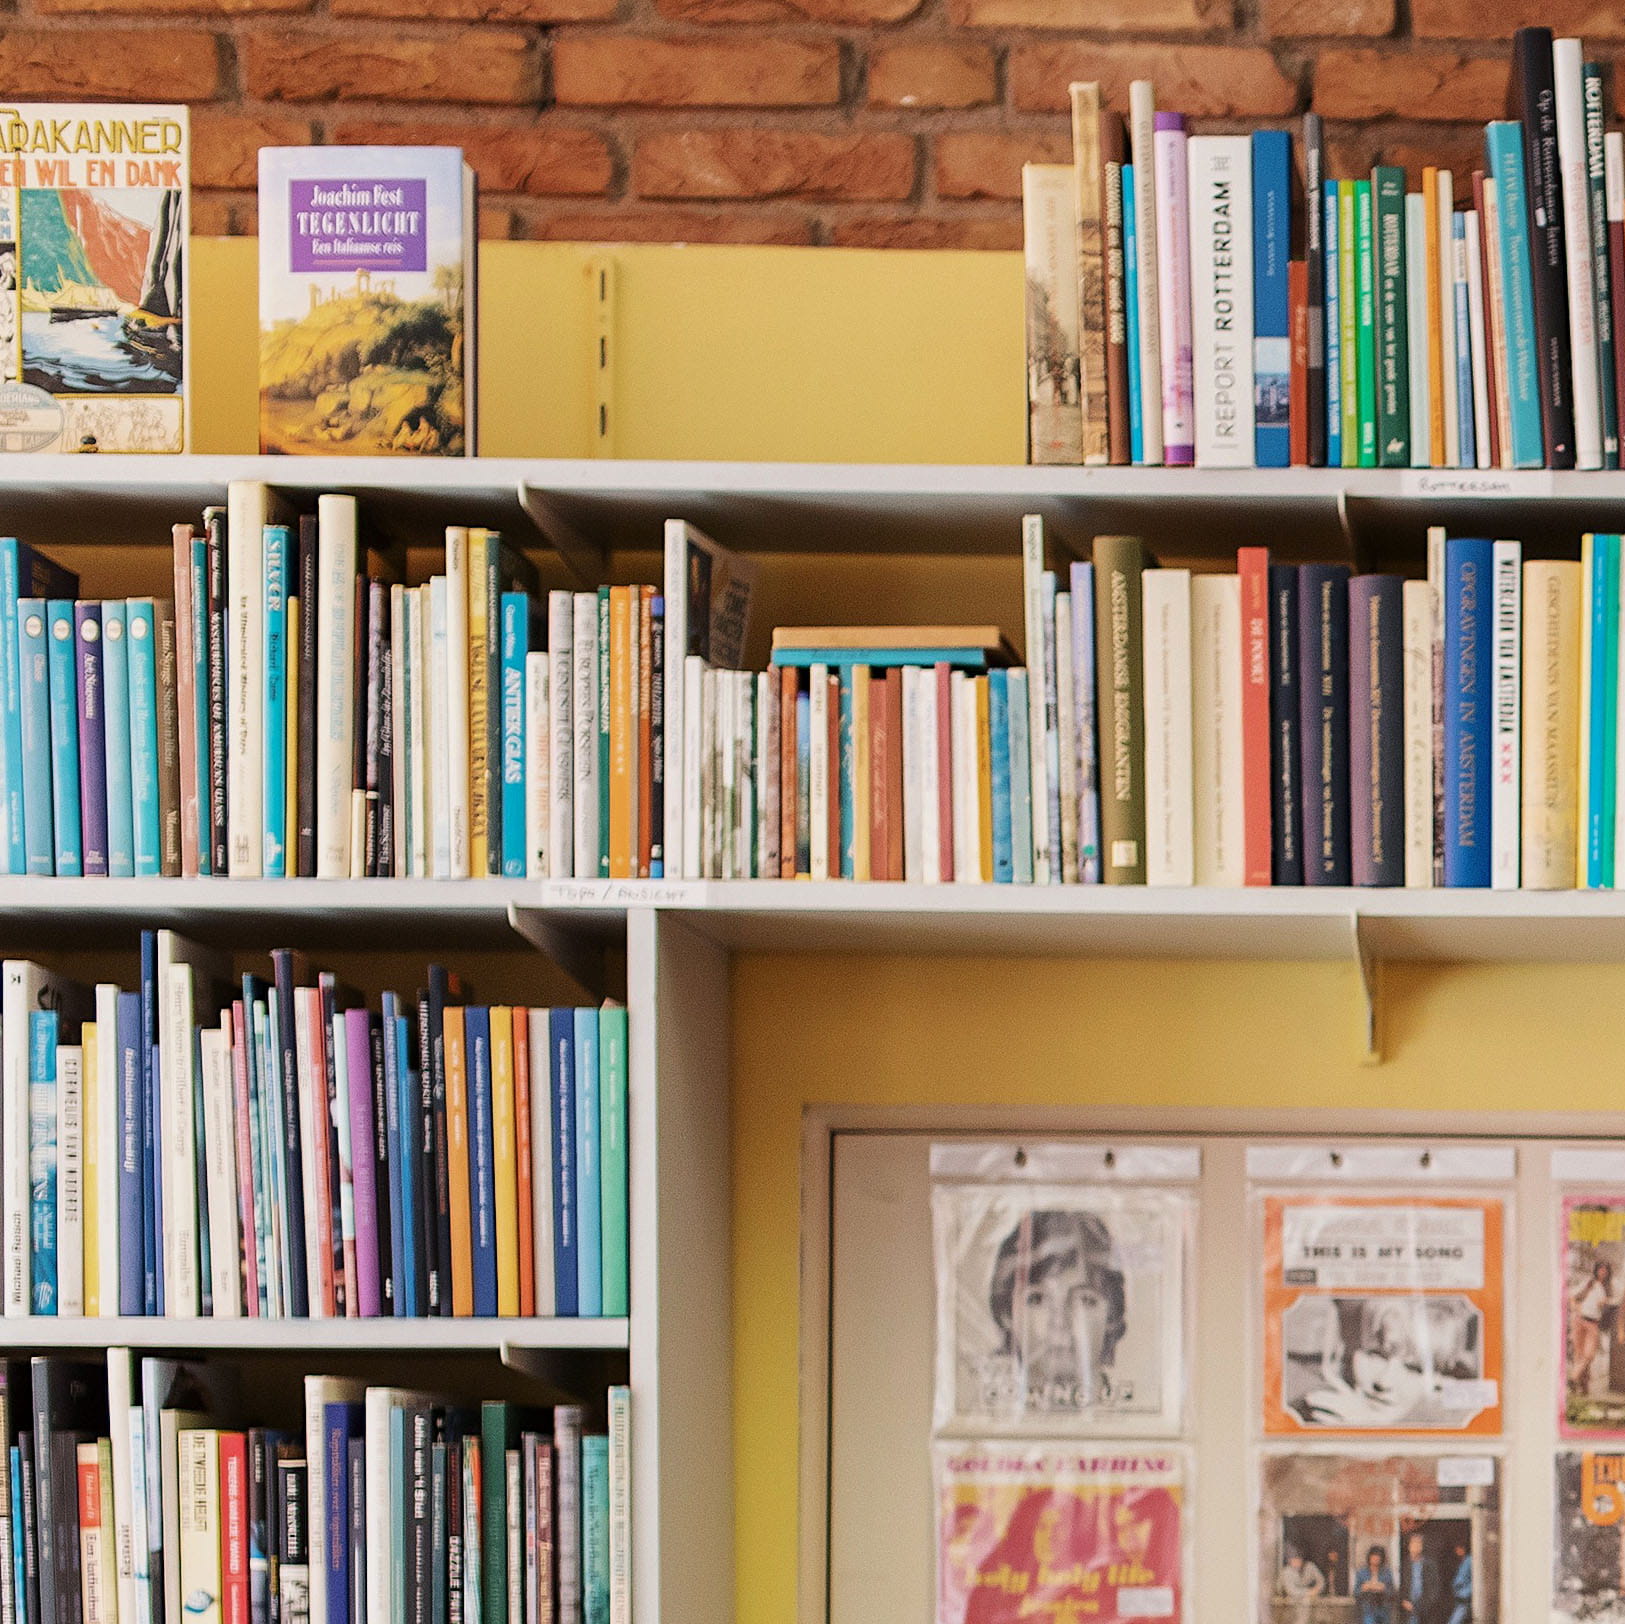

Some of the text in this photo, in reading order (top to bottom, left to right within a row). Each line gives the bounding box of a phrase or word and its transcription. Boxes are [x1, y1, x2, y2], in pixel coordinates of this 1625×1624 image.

[1584, 77, 1603, 177] ROTTERDAM
[35, 159, 182, 187] WIL EN DANK
[310, 184, 404, 207] Joachim Fest
[295, 210, 421, 237] TEGENLICHT
[1213, 181, 1236, 439] REPORT ROTTERDAM
[266, 539, 281, 612] SILVER
[504, 667, 521, 784] ANTIEK GLAS
[1458, 562, 1476, 847] OPGRAVINGEN IN AMSTERDAM
[1352, 1246, 1367, 1259] IS
[1377, 1246, 1403, 1259] MY
[1416, 1246, 1464, 1259] SONG
